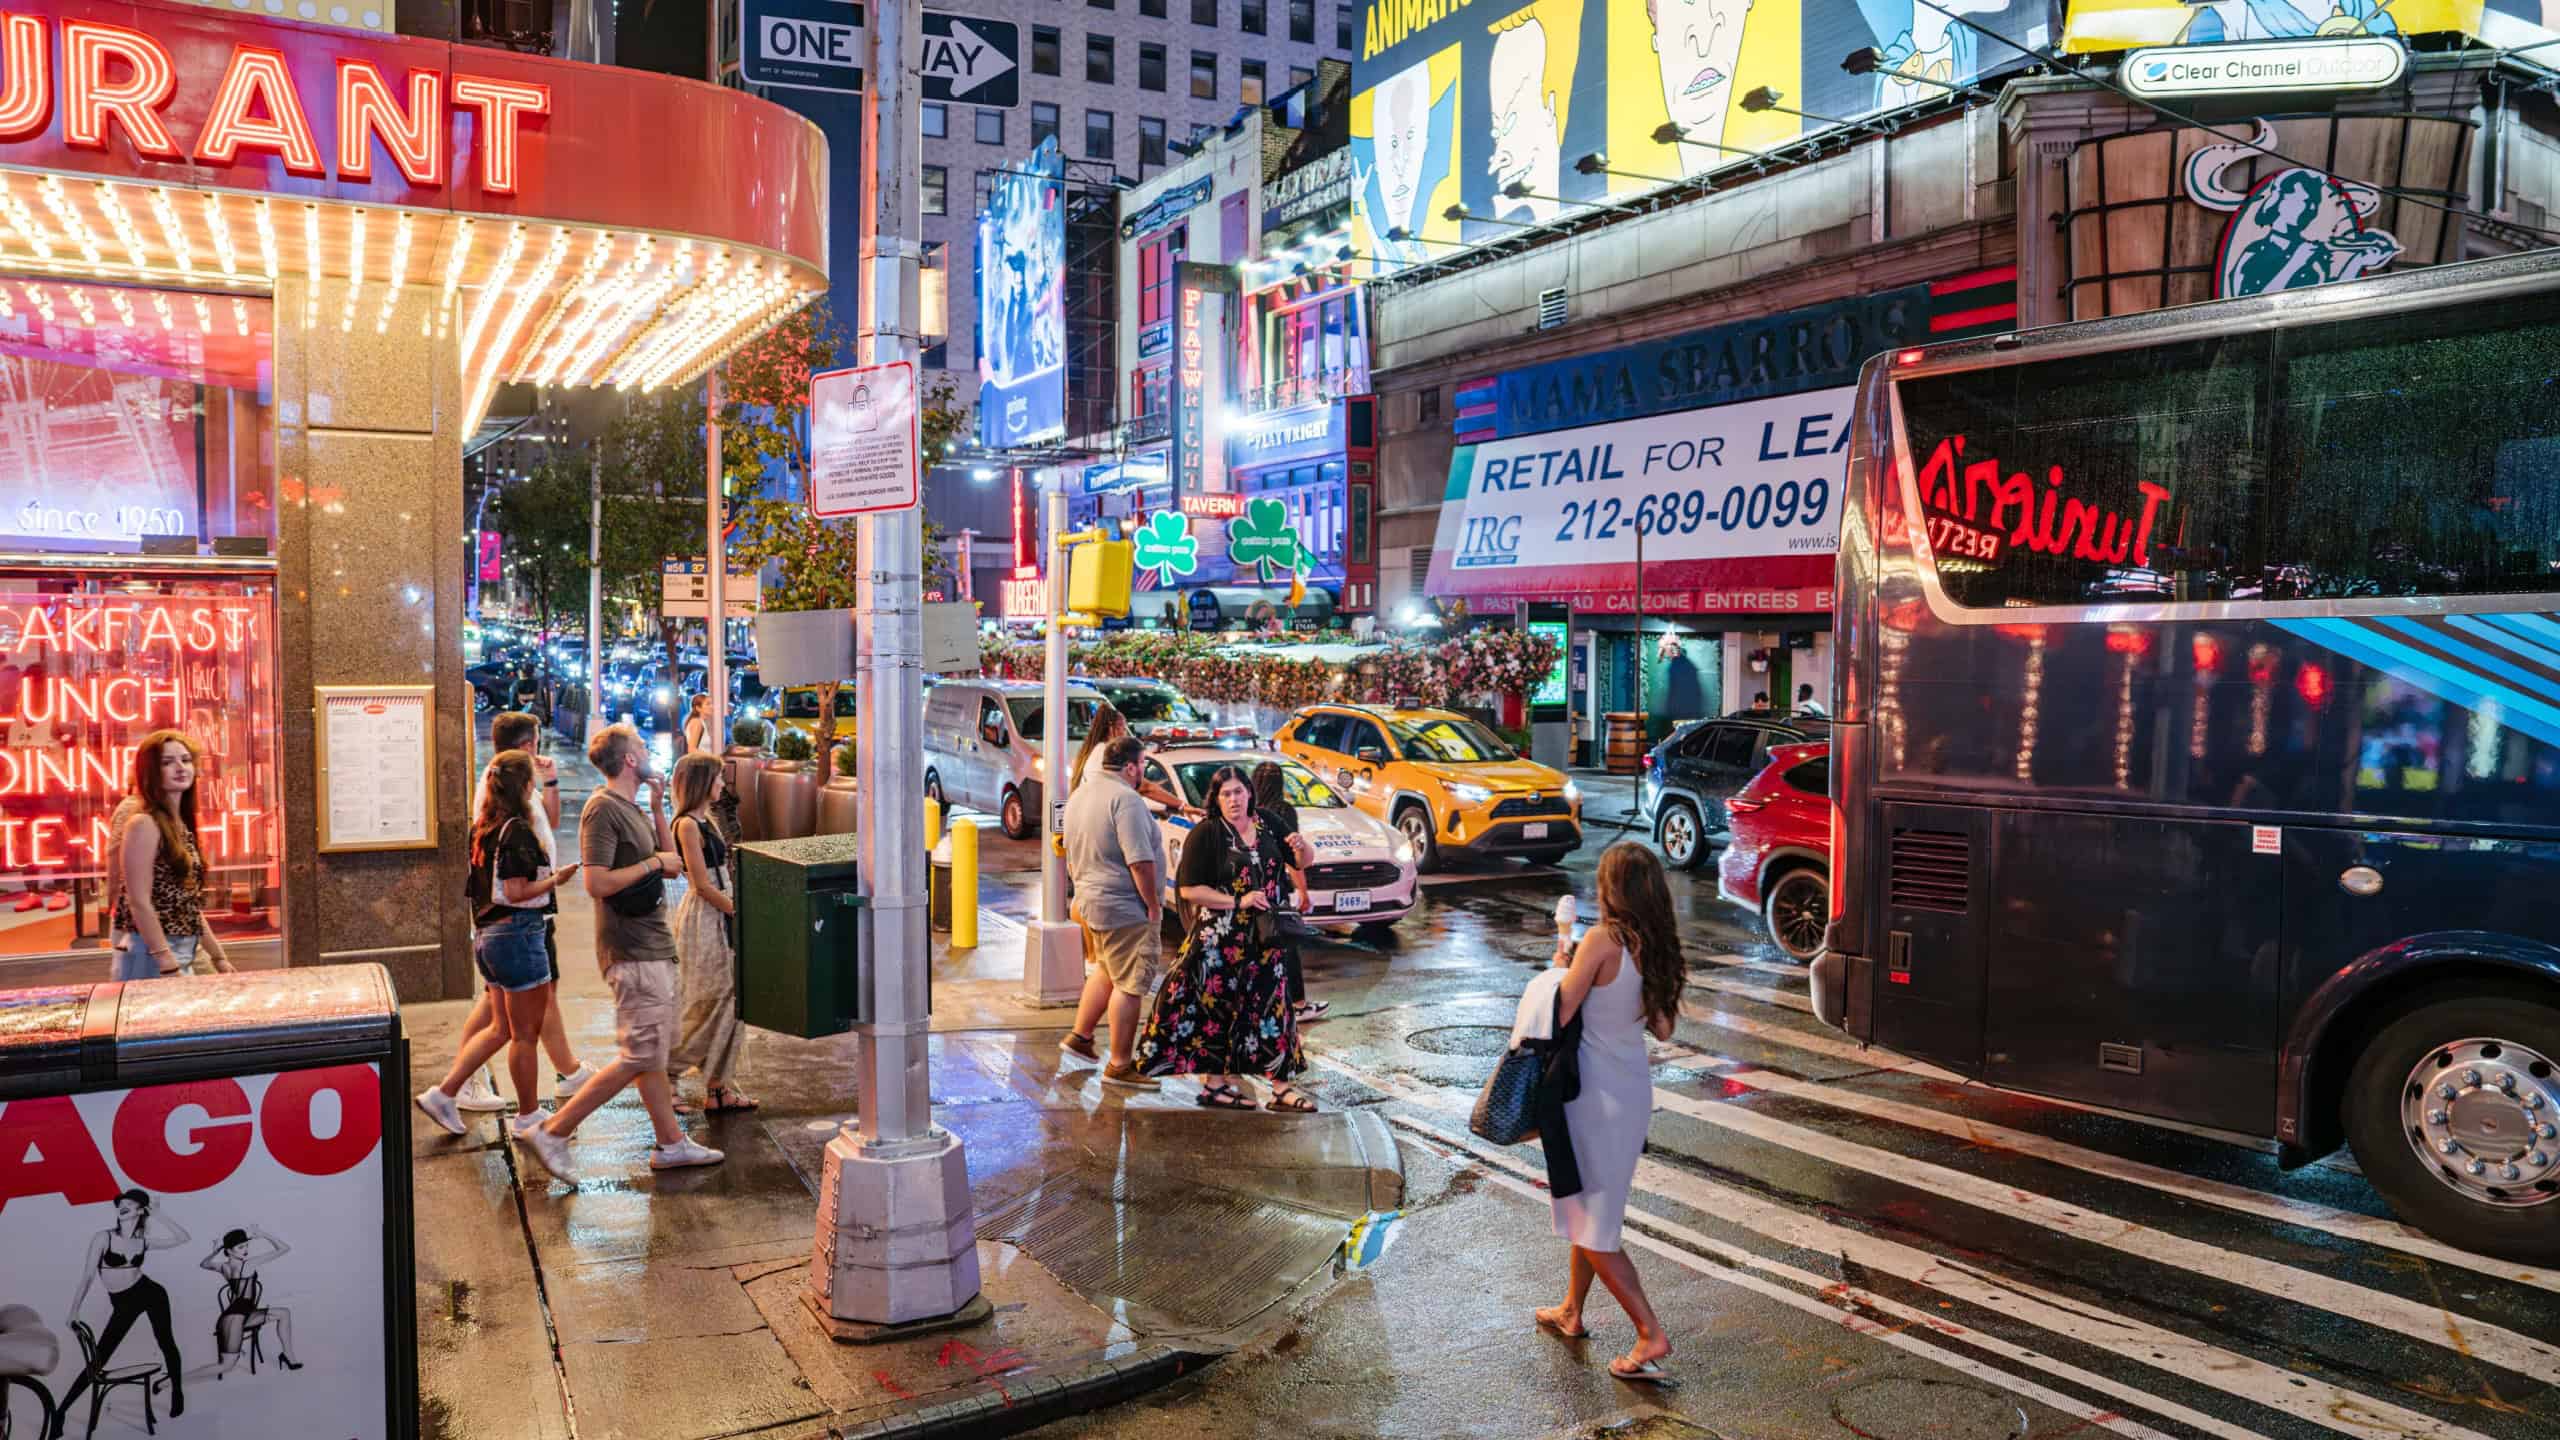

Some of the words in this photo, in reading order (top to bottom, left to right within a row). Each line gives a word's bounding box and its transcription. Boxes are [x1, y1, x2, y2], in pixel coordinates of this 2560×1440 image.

[770, 21, 852, 63] ONE
[2172, 63, 2220, 80] Clear
[2226, 60, 2301, 78] Channel
[2307, 57, 2383, 75] Outdoor
[1182, 288, 1203, 489] PLAYWRIGHT
[1506, 362, 1640, 424] MAMA
[1256, 420, 1328, 450] PLAYWRIGHT
[1481, 444, 1625, 493] RETAIL
[1643, 437, 1725, 475] FOR
[17, 503, 100, 534] since
[117, 505, 185, 537] 1950
[1183, 496, 1237, 514] TAVERN
[1555, 478, 1830, 542] 212-689-0099
[1461, 515, 1523, 554] IRG
[1483, 596, 1525, 610] PAST
[1606, 592, 1690, 609] CALZONE
[1705, 591, 1799, 609] ENTREES
[0, 606, 249, 652] AKFAST
